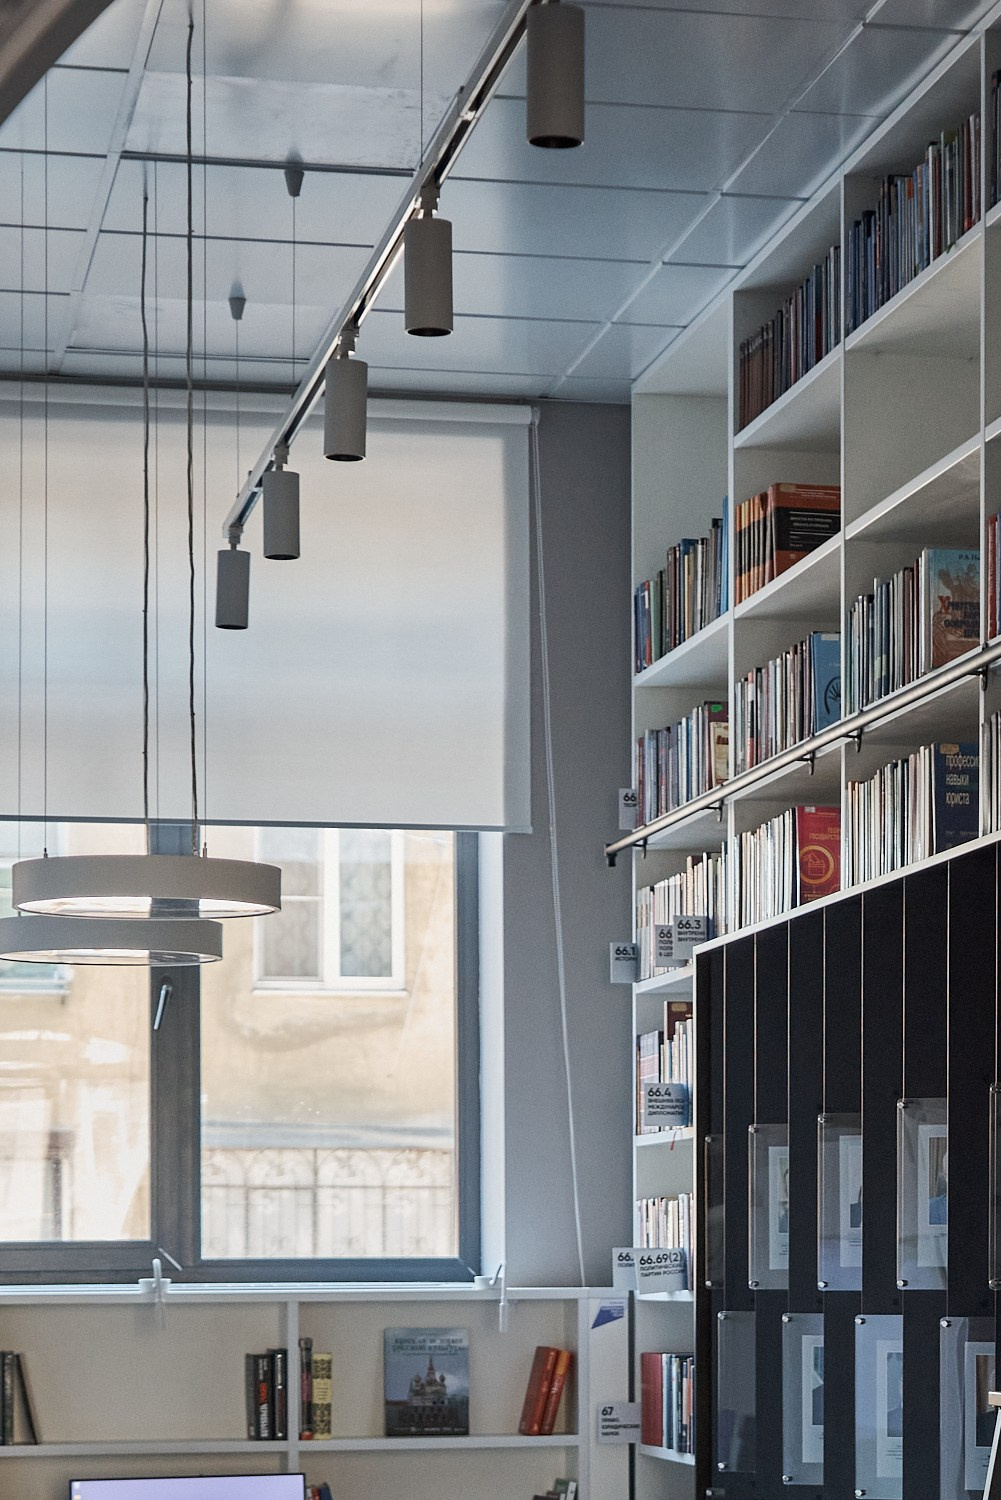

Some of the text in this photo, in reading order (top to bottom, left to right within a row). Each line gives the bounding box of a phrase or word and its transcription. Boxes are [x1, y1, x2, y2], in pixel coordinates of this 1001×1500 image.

[945, 774, 970, 786] навыки
[945, 792, 970, 806] юриста
[678, 919, 701, 930] 66.3
[615, 946, 636, 956] 66.1
[648, 1087, 671, 1097] 66.4
[640, 1252, 682, 1266] 66.69(2)
[601, 1406, 614, 1416] 67
